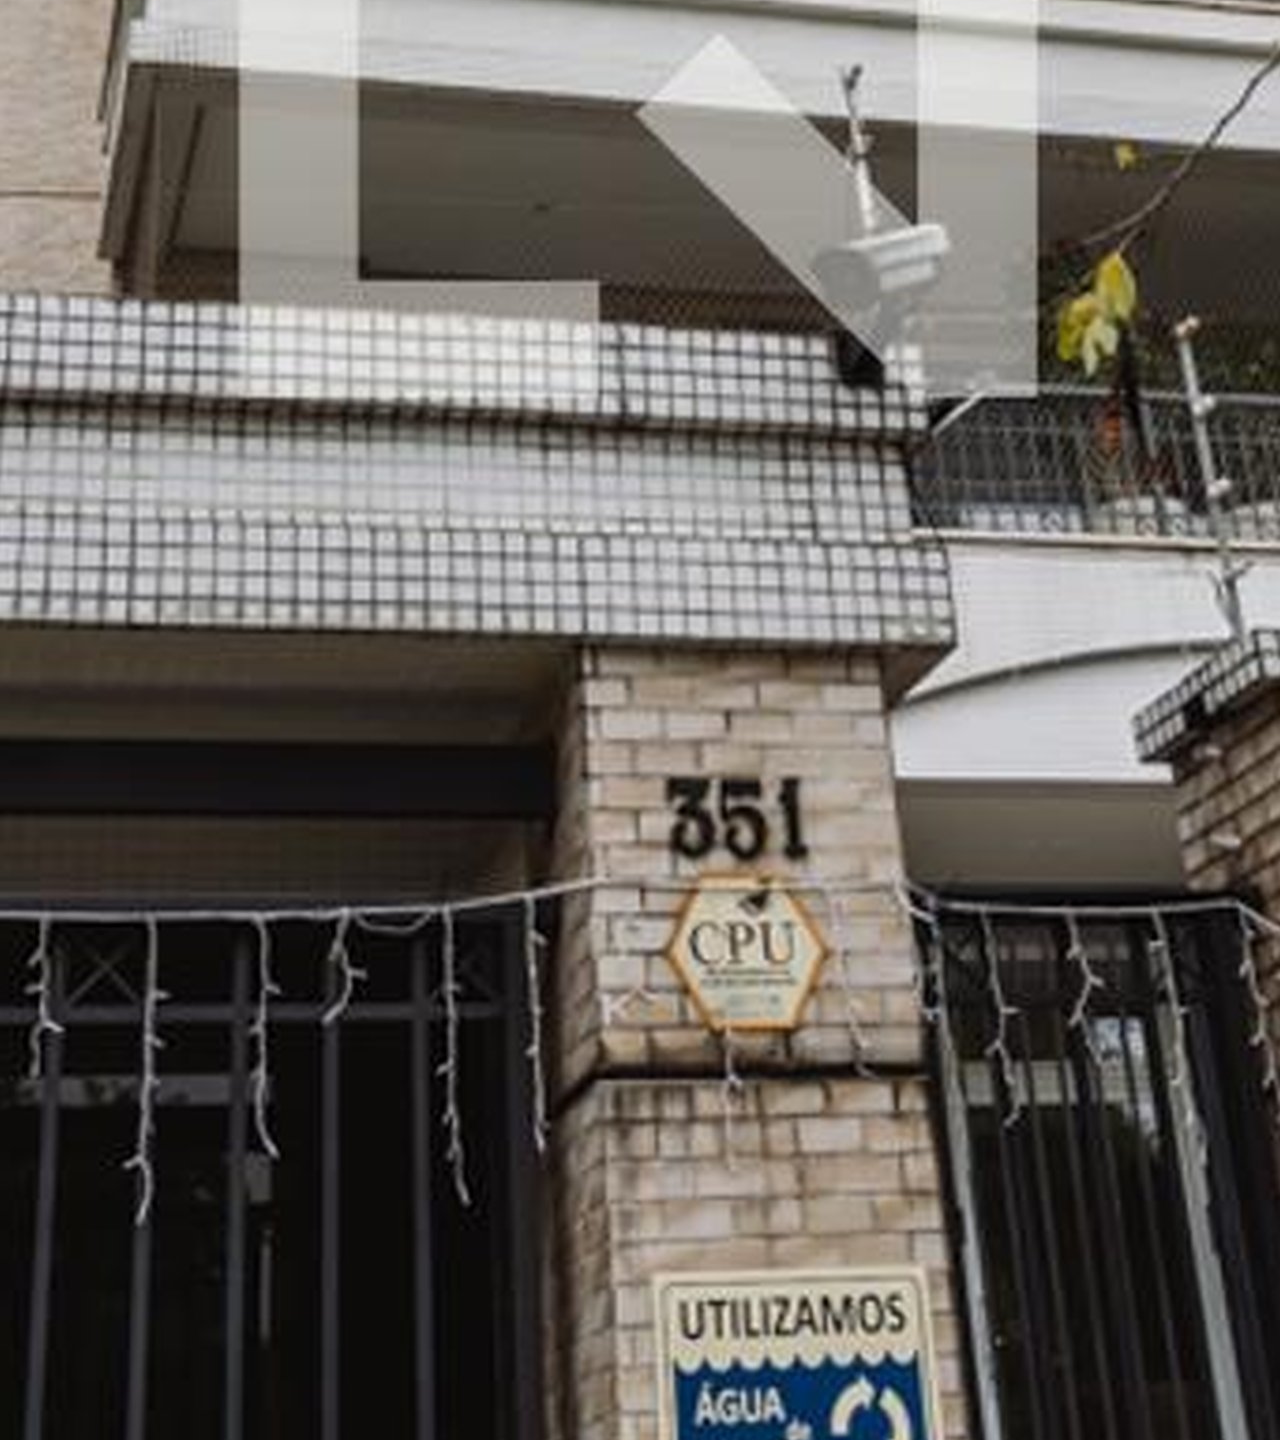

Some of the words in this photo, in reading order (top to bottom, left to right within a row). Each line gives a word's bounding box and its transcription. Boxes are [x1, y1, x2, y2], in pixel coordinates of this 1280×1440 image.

[665, 776, 810, 861] 351
[688, 920, 796, 967] CPU
[677, 1292, 907, 1340] UTILIZAMOS
[694, 1382, 786, 1426] ÁGUA
